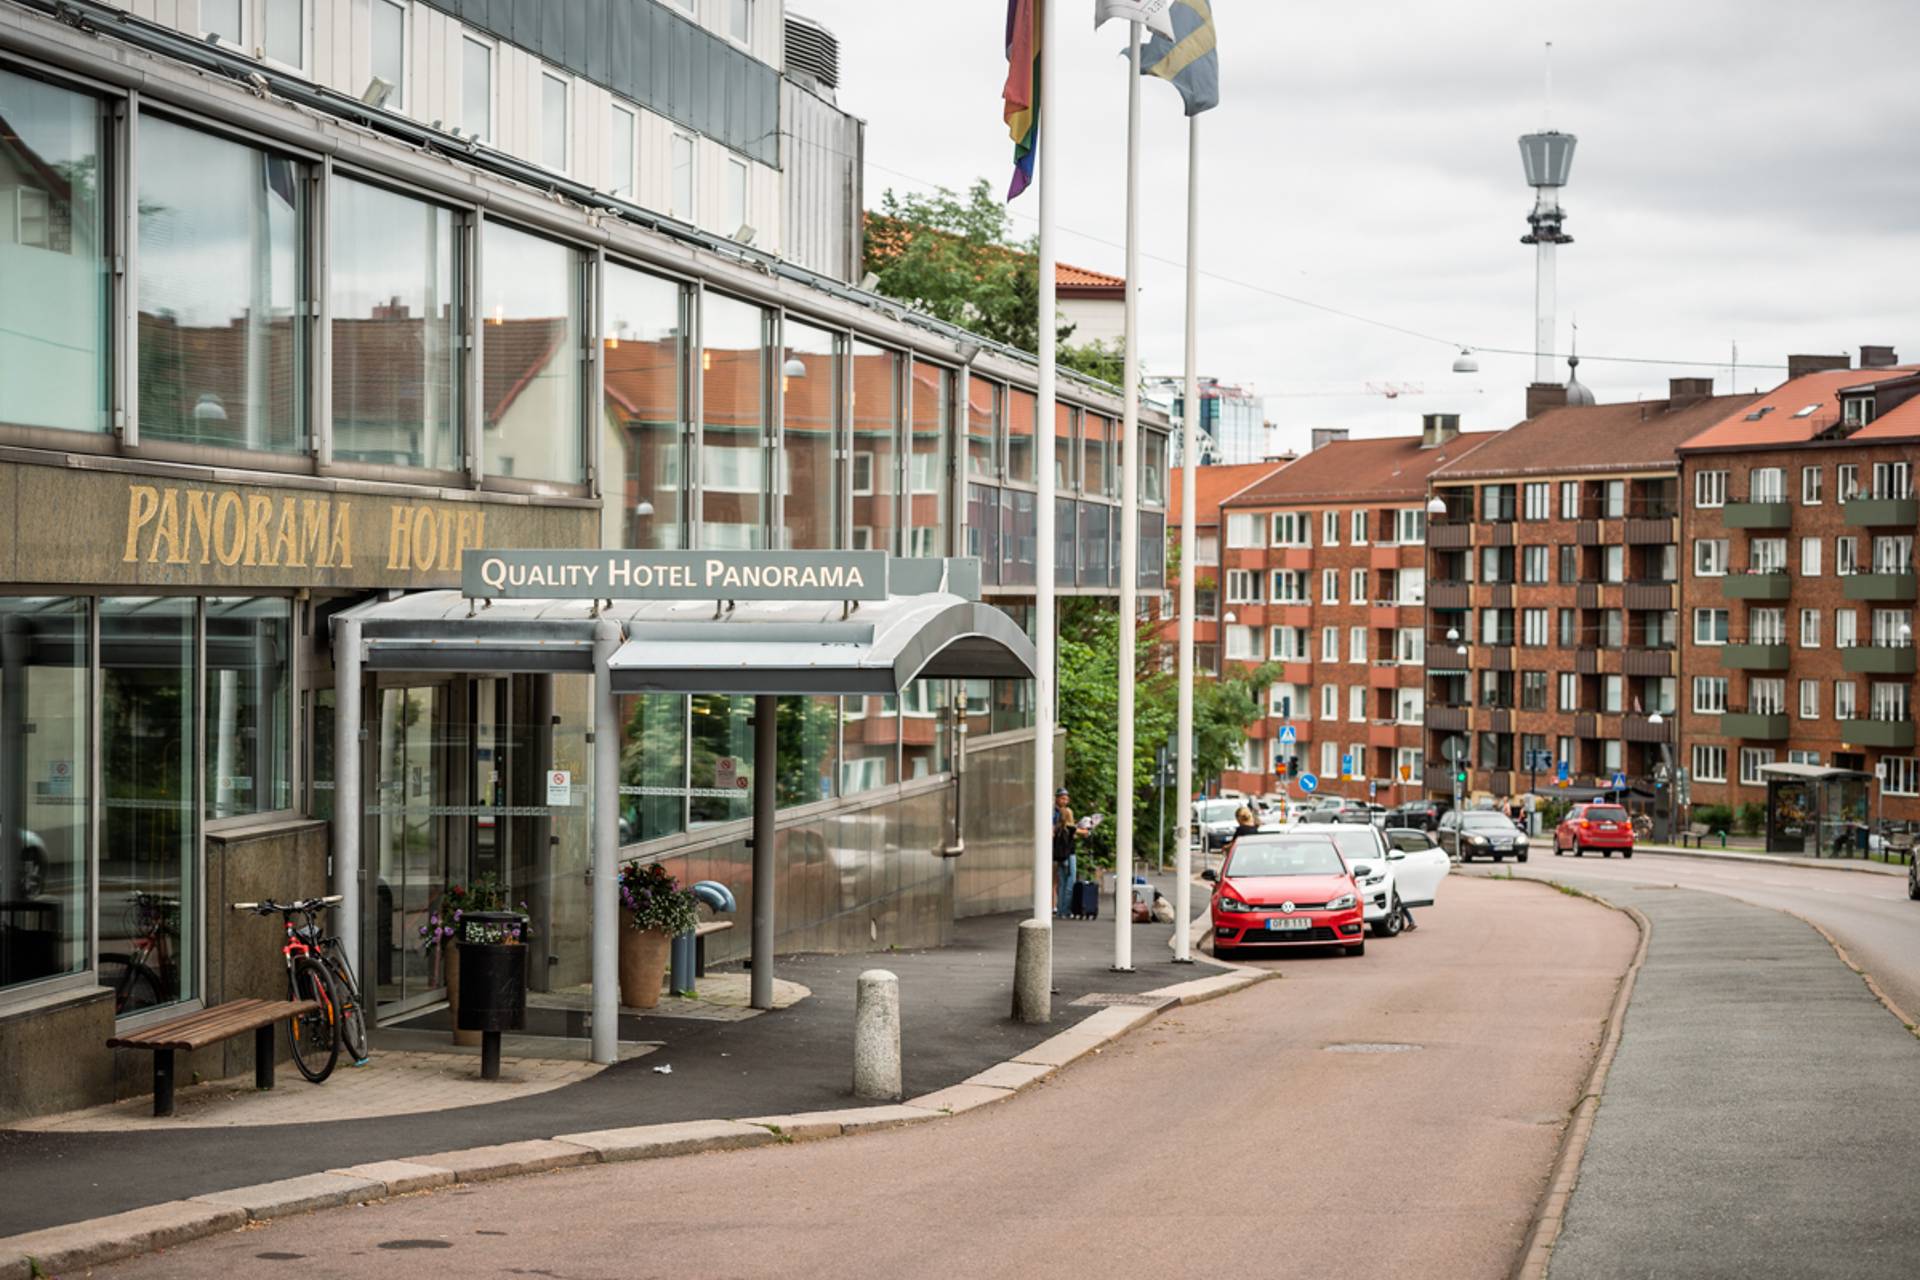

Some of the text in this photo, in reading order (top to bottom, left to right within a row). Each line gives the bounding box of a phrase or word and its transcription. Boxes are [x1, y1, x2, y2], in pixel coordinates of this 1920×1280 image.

[123, 485, 353, 568] PANORAMA
[481, 558, 865, 590] QUALITY HOTEL PANORAMA
